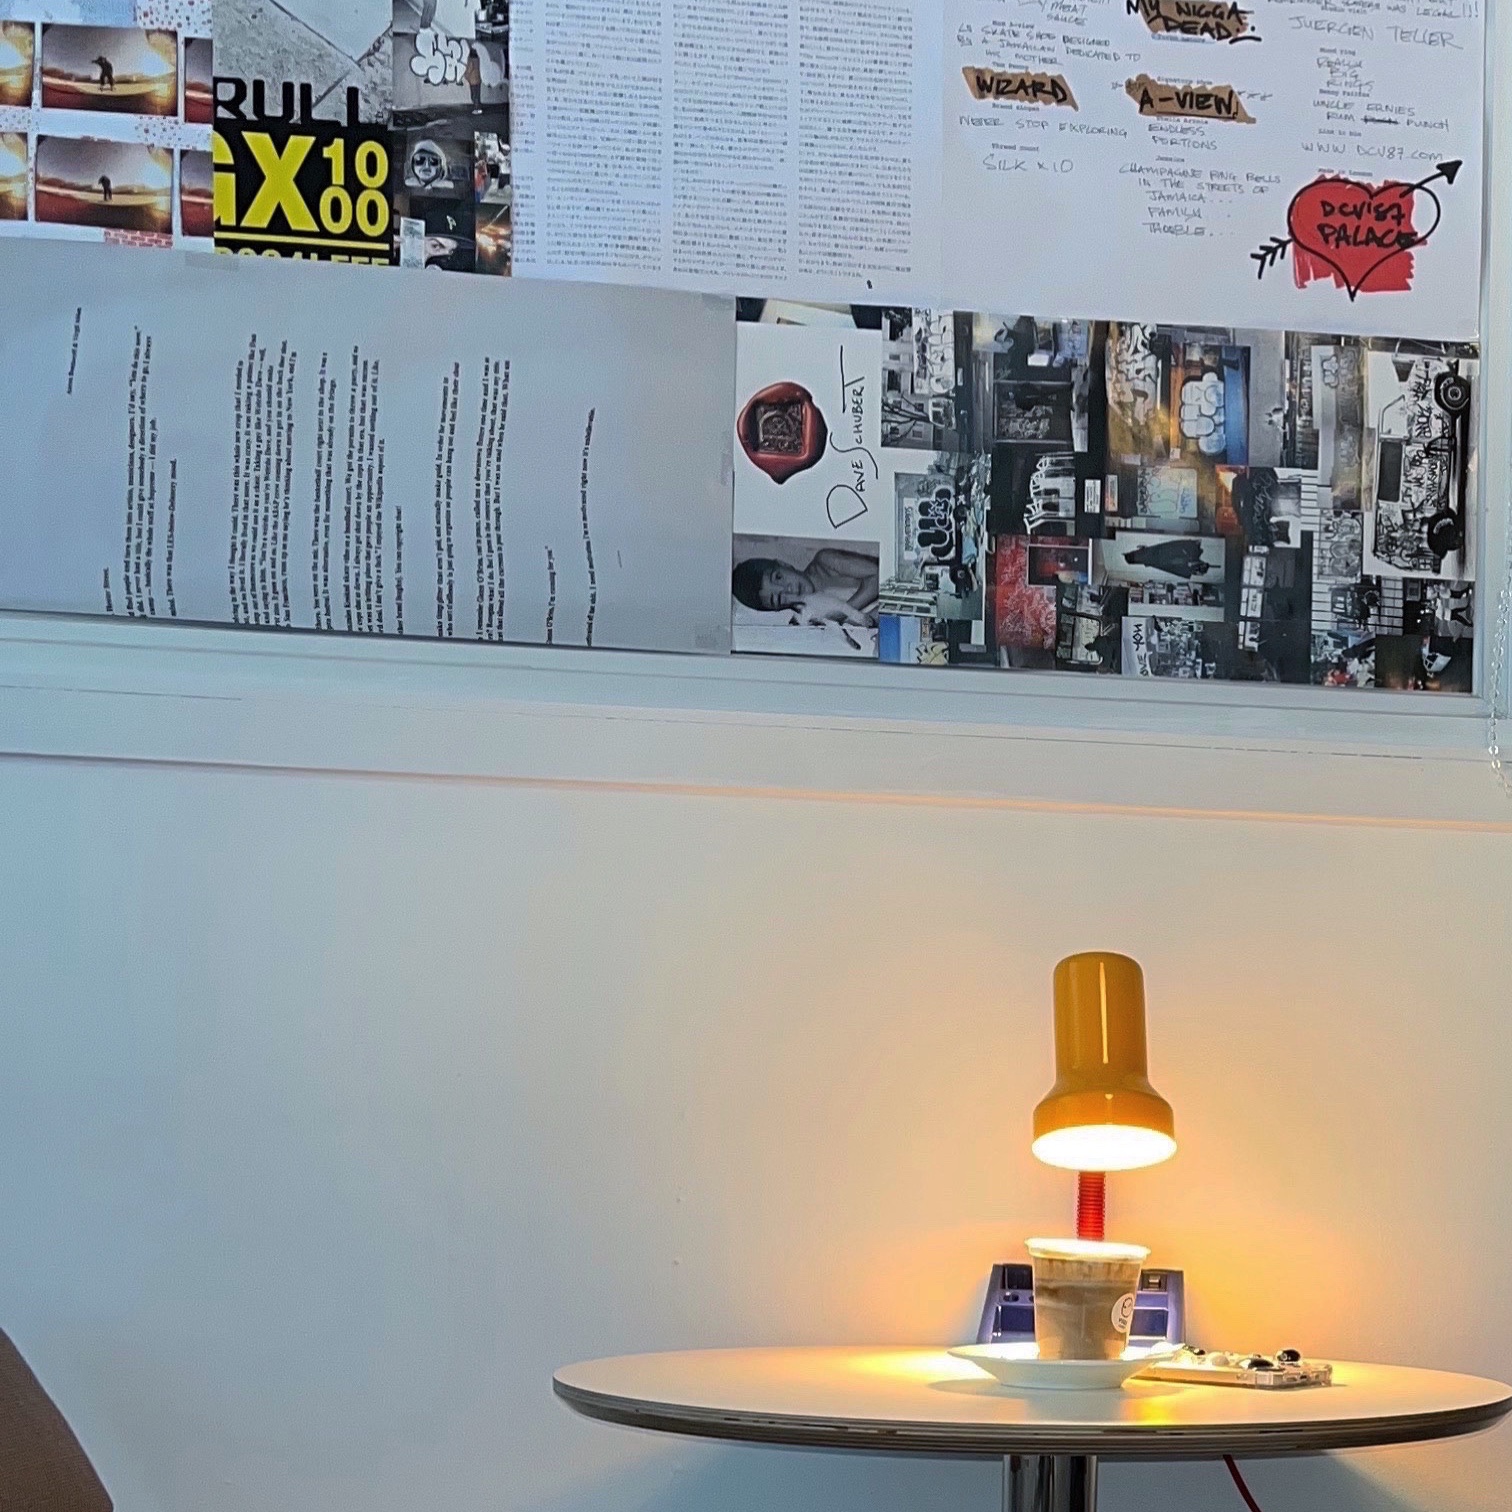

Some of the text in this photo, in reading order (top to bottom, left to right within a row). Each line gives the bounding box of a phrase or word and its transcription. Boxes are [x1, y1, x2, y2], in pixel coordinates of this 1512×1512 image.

[1175, 1, 1254, 26] NIGGA
[1288, 16, 1463, 50] JUERGEN TELLER
[1015, 53, 1058, 65] MOTHER
[1125, 53, 1141, 62] TO
[976, 75, 1067, 102] WIZARD
[1015, 119, 1049, 130] STOP
[1059, 122, 1127, 138] EXPLORING
[1148, 124, 1205, 136] ENDLESS
[1152, 136, 1217, 150] PORTIONS
[323, 137, 389, 189] 10
[983, 153, 1027, 172] SILK
[1161, 179, 1184, 189] THE
[319, 185, 390, 237] 00
[1317, 223, 1418, 249] PALACE
[826, 345, 878, 529] DAVE SCHUBERT
